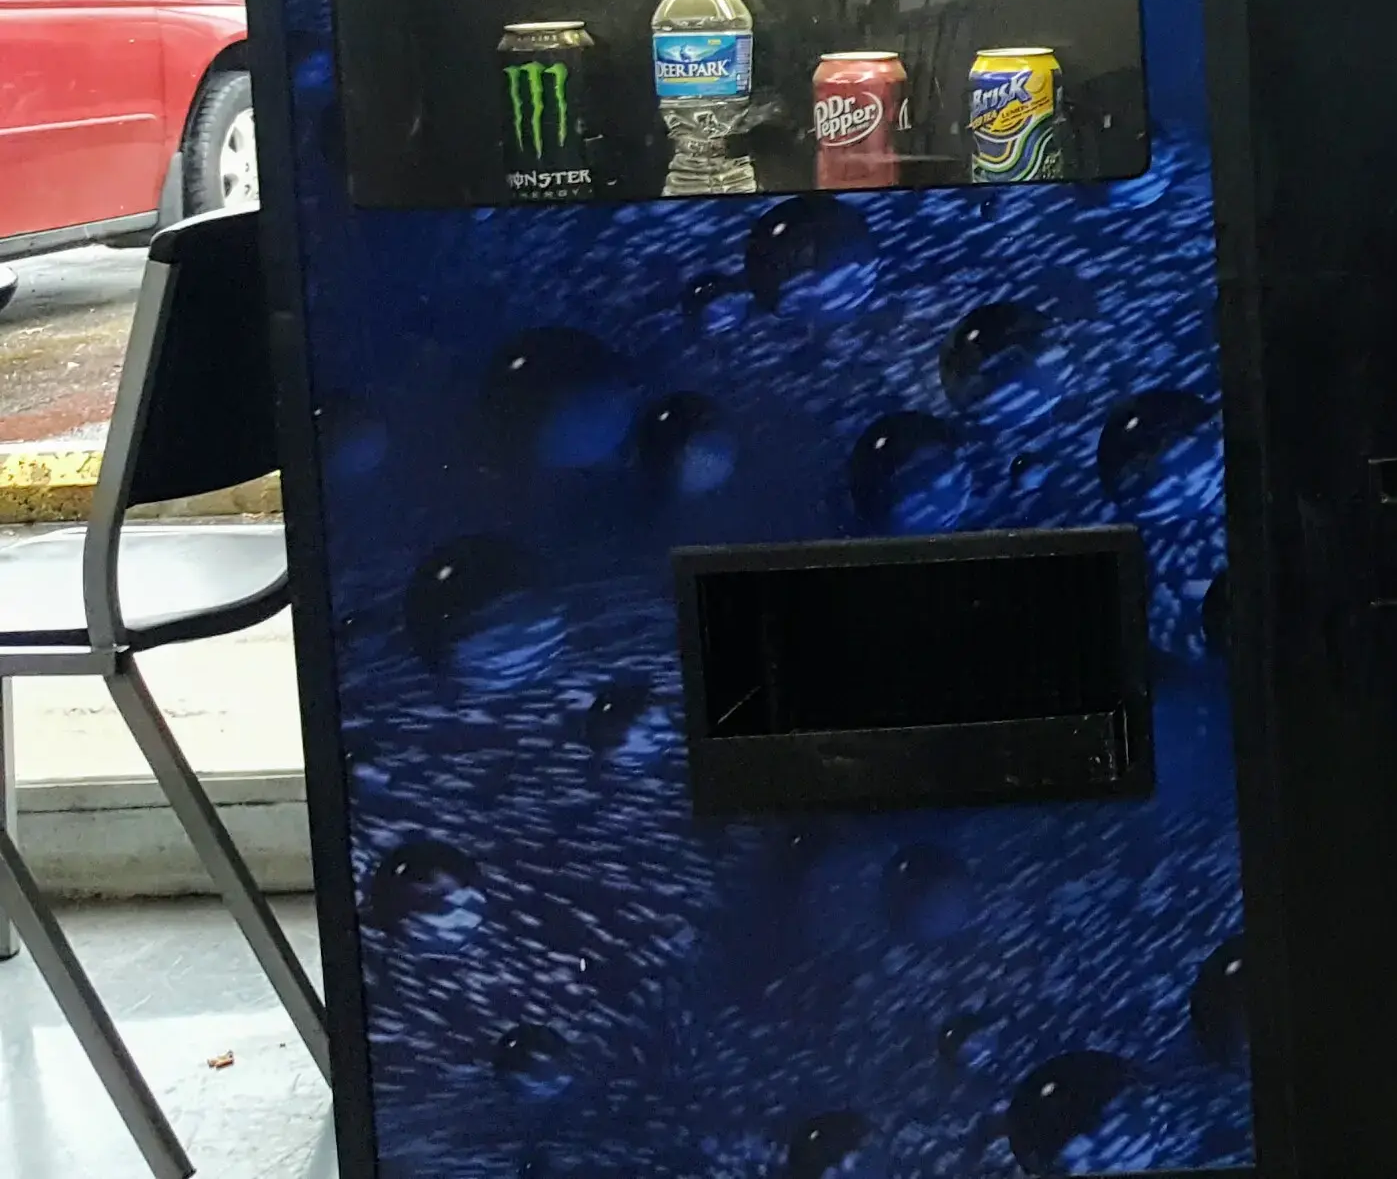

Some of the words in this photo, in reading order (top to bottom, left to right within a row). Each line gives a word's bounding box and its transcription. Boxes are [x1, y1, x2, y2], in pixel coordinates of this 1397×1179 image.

[687, 59, 730, 78] PARK
[827, 95, 856, 116] Dr
[814, 100, 876, 141] Pepper
